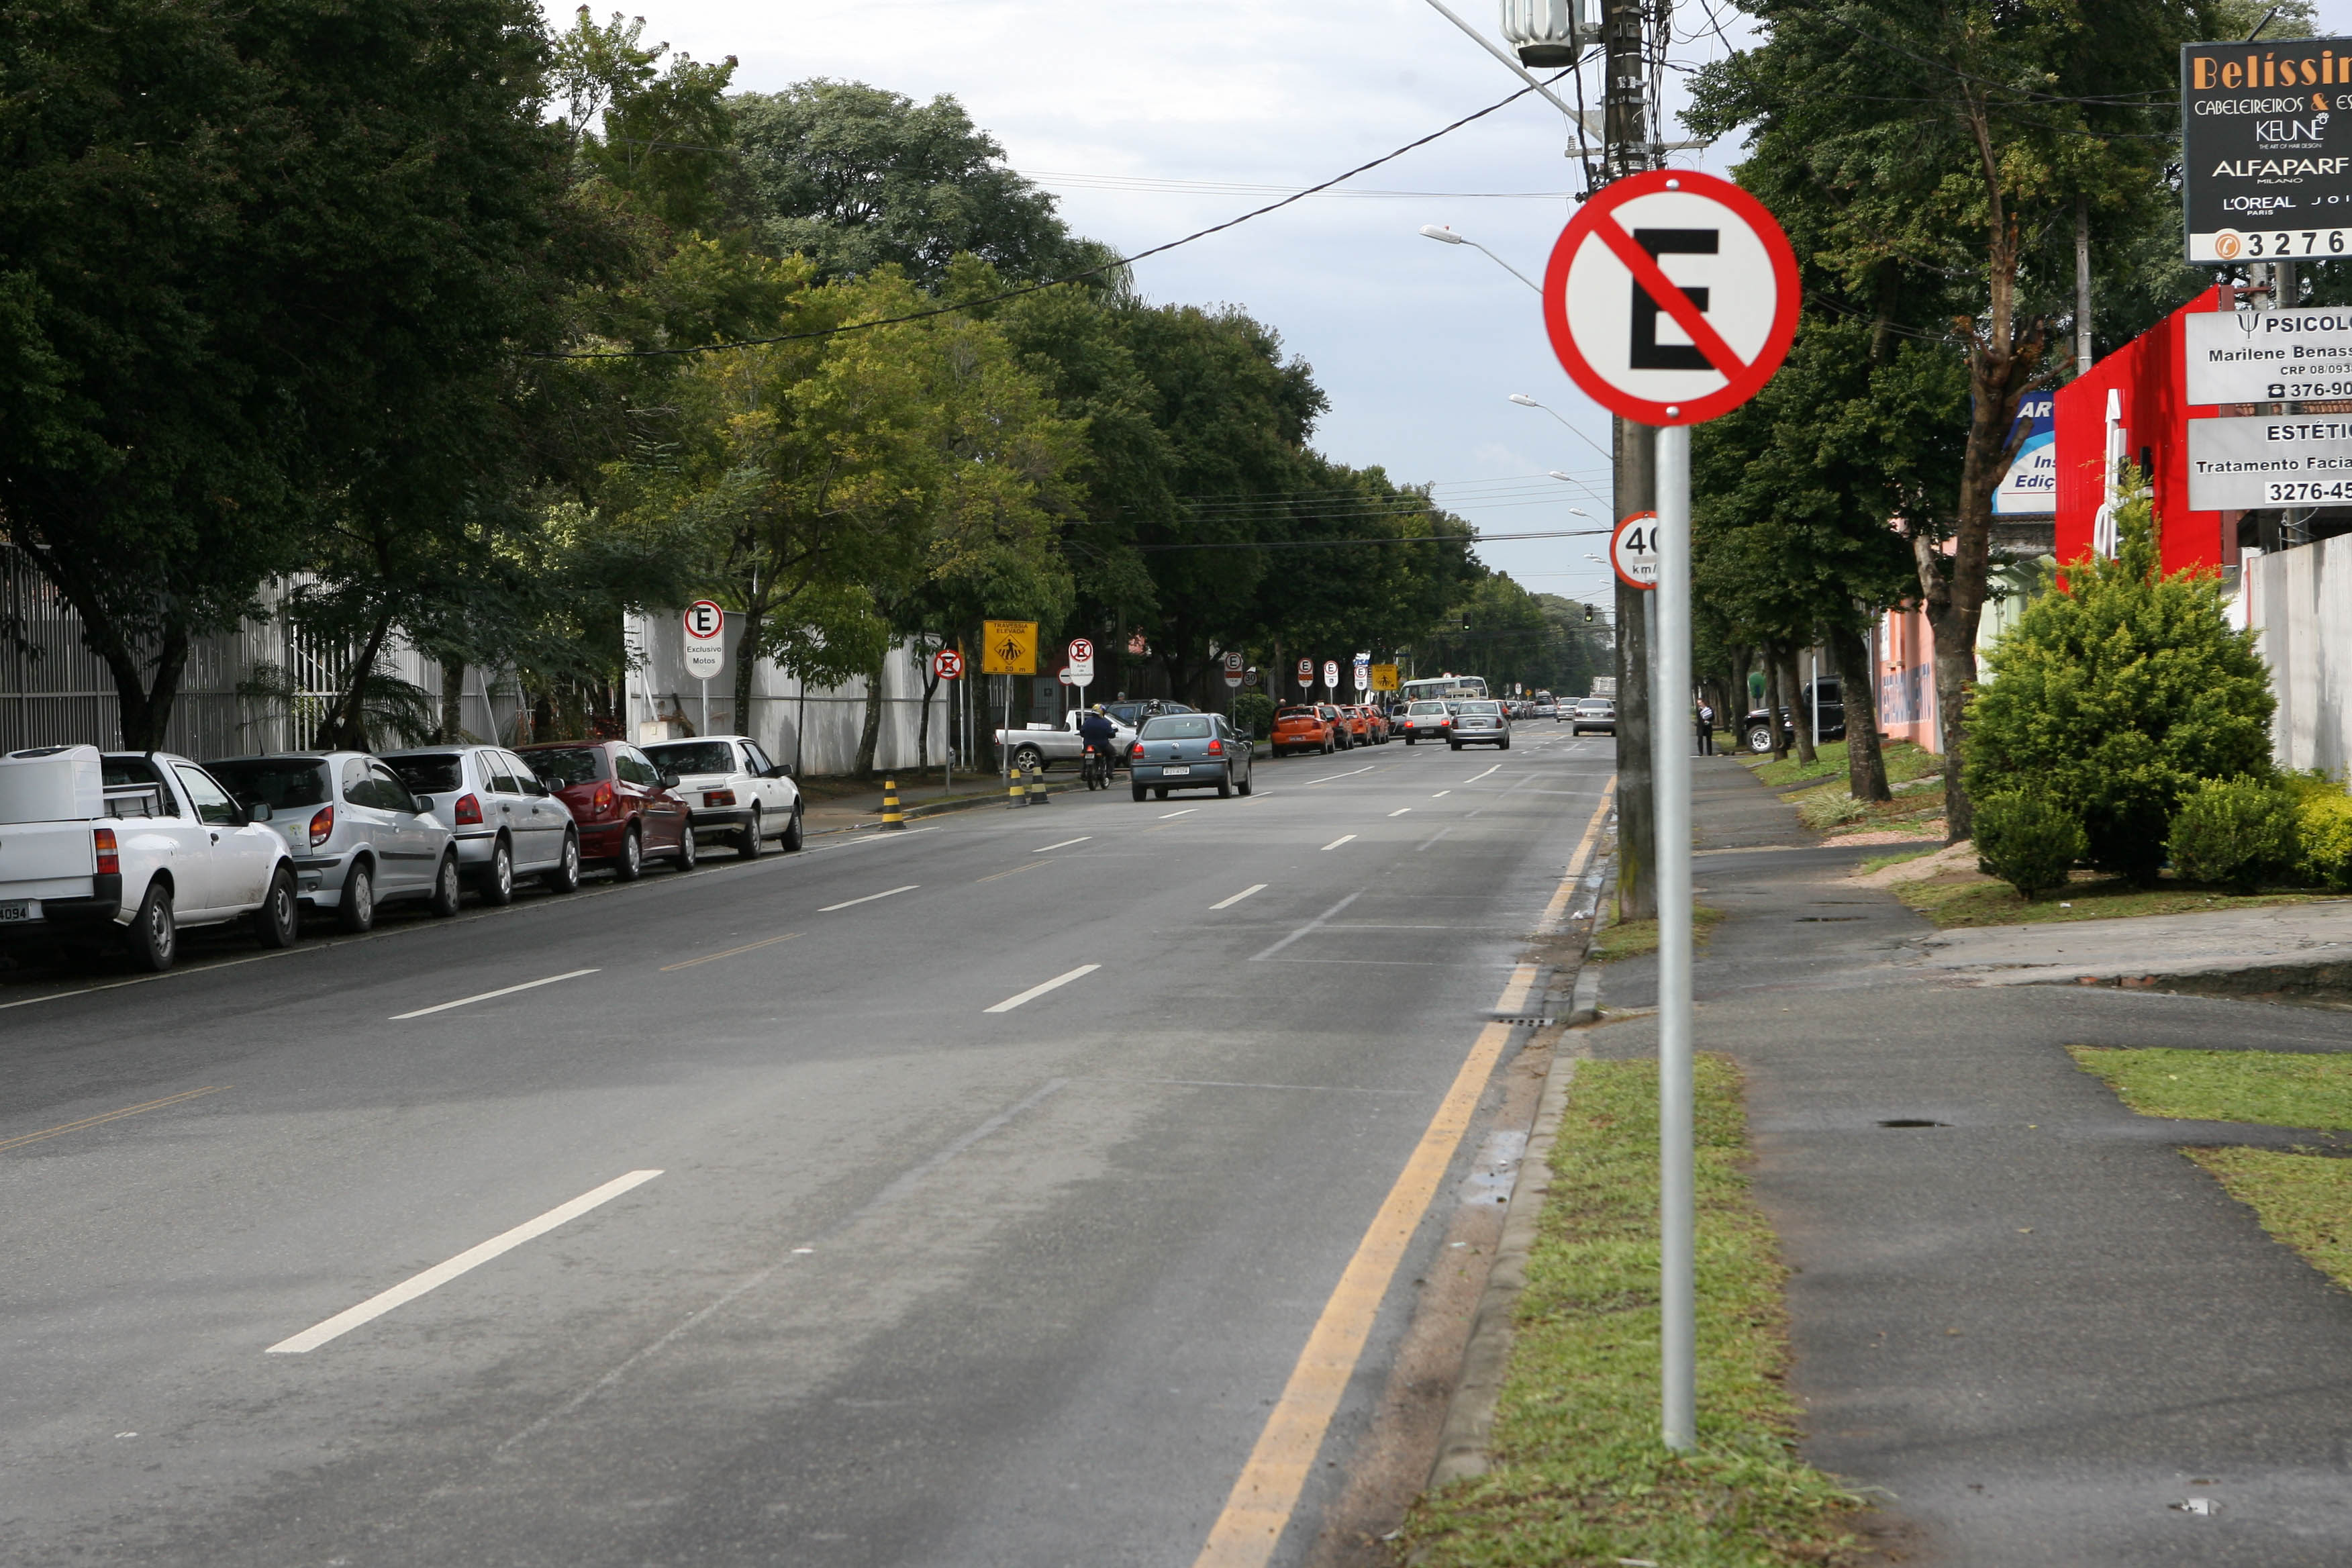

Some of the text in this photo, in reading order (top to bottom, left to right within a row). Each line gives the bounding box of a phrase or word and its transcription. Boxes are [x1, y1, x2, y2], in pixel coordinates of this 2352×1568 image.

[2194, 97, 2304, 115] CABELEIREIROS
[2310, 93, 2329, 111] &
[2256, 119, 2324, 142] KEUNE
[2211, 157, 2350, 177] ALFAPARF
[2248, 230, 2345, 256] 3276
[1630, 228, 1720, 371] E
[2266, 316, 2352, 333] PSICOL
[2209, 348, 2286, 362] Marilene
[2280, 364, 2352, 375] CRP 08/093
[2290, 383, 2352, 397] 376-90
[2016, 401, 2055, 419] AR
[2267, 421, 2352, 440] ESTÉTI
[2196, 456, 2352, 474] Tratamento Facia
[2015, 475, 2055, 491] Ediç
[2270, 482, 2352, 501] 3276-45
[696, 607, 712, 631] E
[1230, 656, 1237, 667] E
[1302, 661, 1308, 671] E
[1328, 664, 1334, 672] E
[1358, 668, 1363, 676] E
